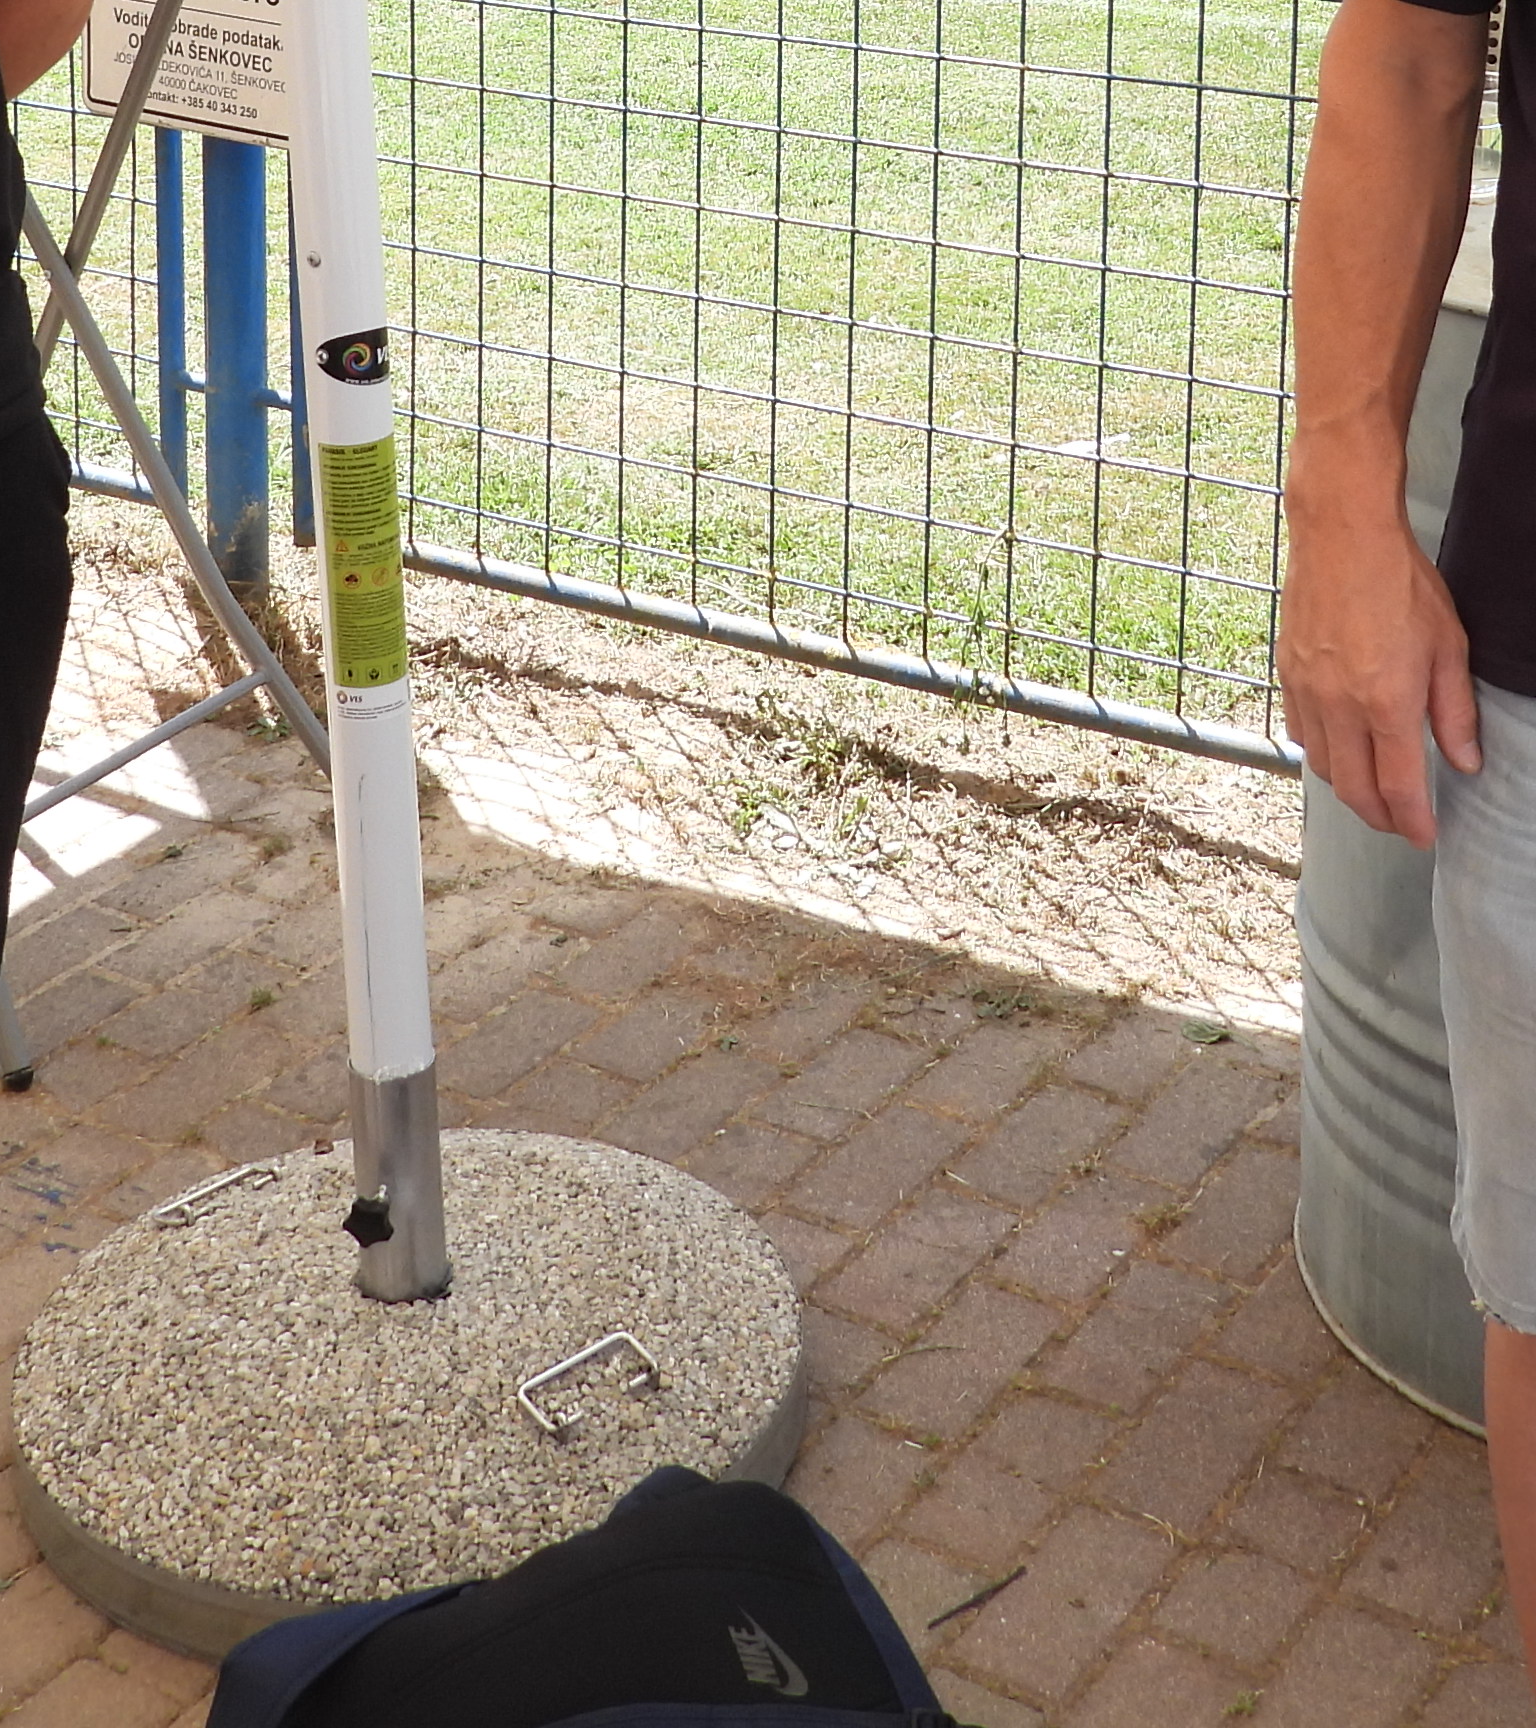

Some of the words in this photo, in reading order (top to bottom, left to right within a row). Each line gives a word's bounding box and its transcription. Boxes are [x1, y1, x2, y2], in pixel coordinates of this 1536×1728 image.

[113, 7, 149, 28] Vodit
[222, 30, 283, 52] podatak
[188, 39, 273, 73] ŠENKOVEC
[158, 75, 186, 90] 40000
[147, 90, 179, 104] ontakt:
[181, 95, 204, 109] +385
[206, 100, 218, 112] 40
[220, 102, 238, 116] 343
[239, 106, 258, 119] 250
[727, 1625, 781, 1687] NIKE
